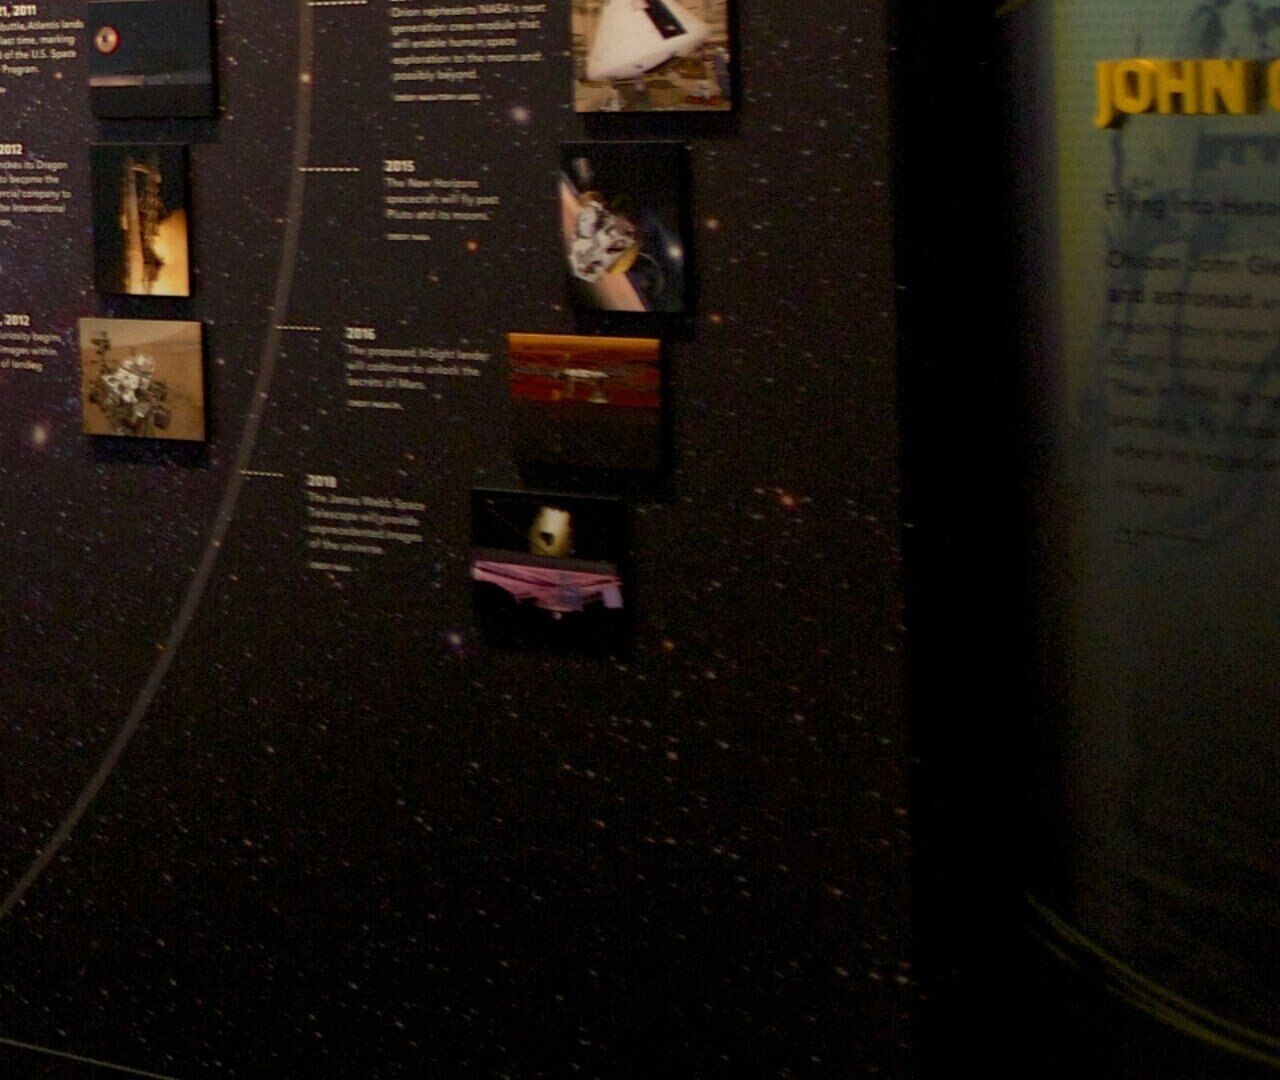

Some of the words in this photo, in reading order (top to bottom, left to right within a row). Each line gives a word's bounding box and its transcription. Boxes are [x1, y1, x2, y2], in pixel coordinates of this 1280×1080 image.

[12, 4, 37, 16] 2011
[1093, 57, 1247, 129] JOHN
[385, 159, 416, 172] 2015
[5, 314, 31, 326] 2012
